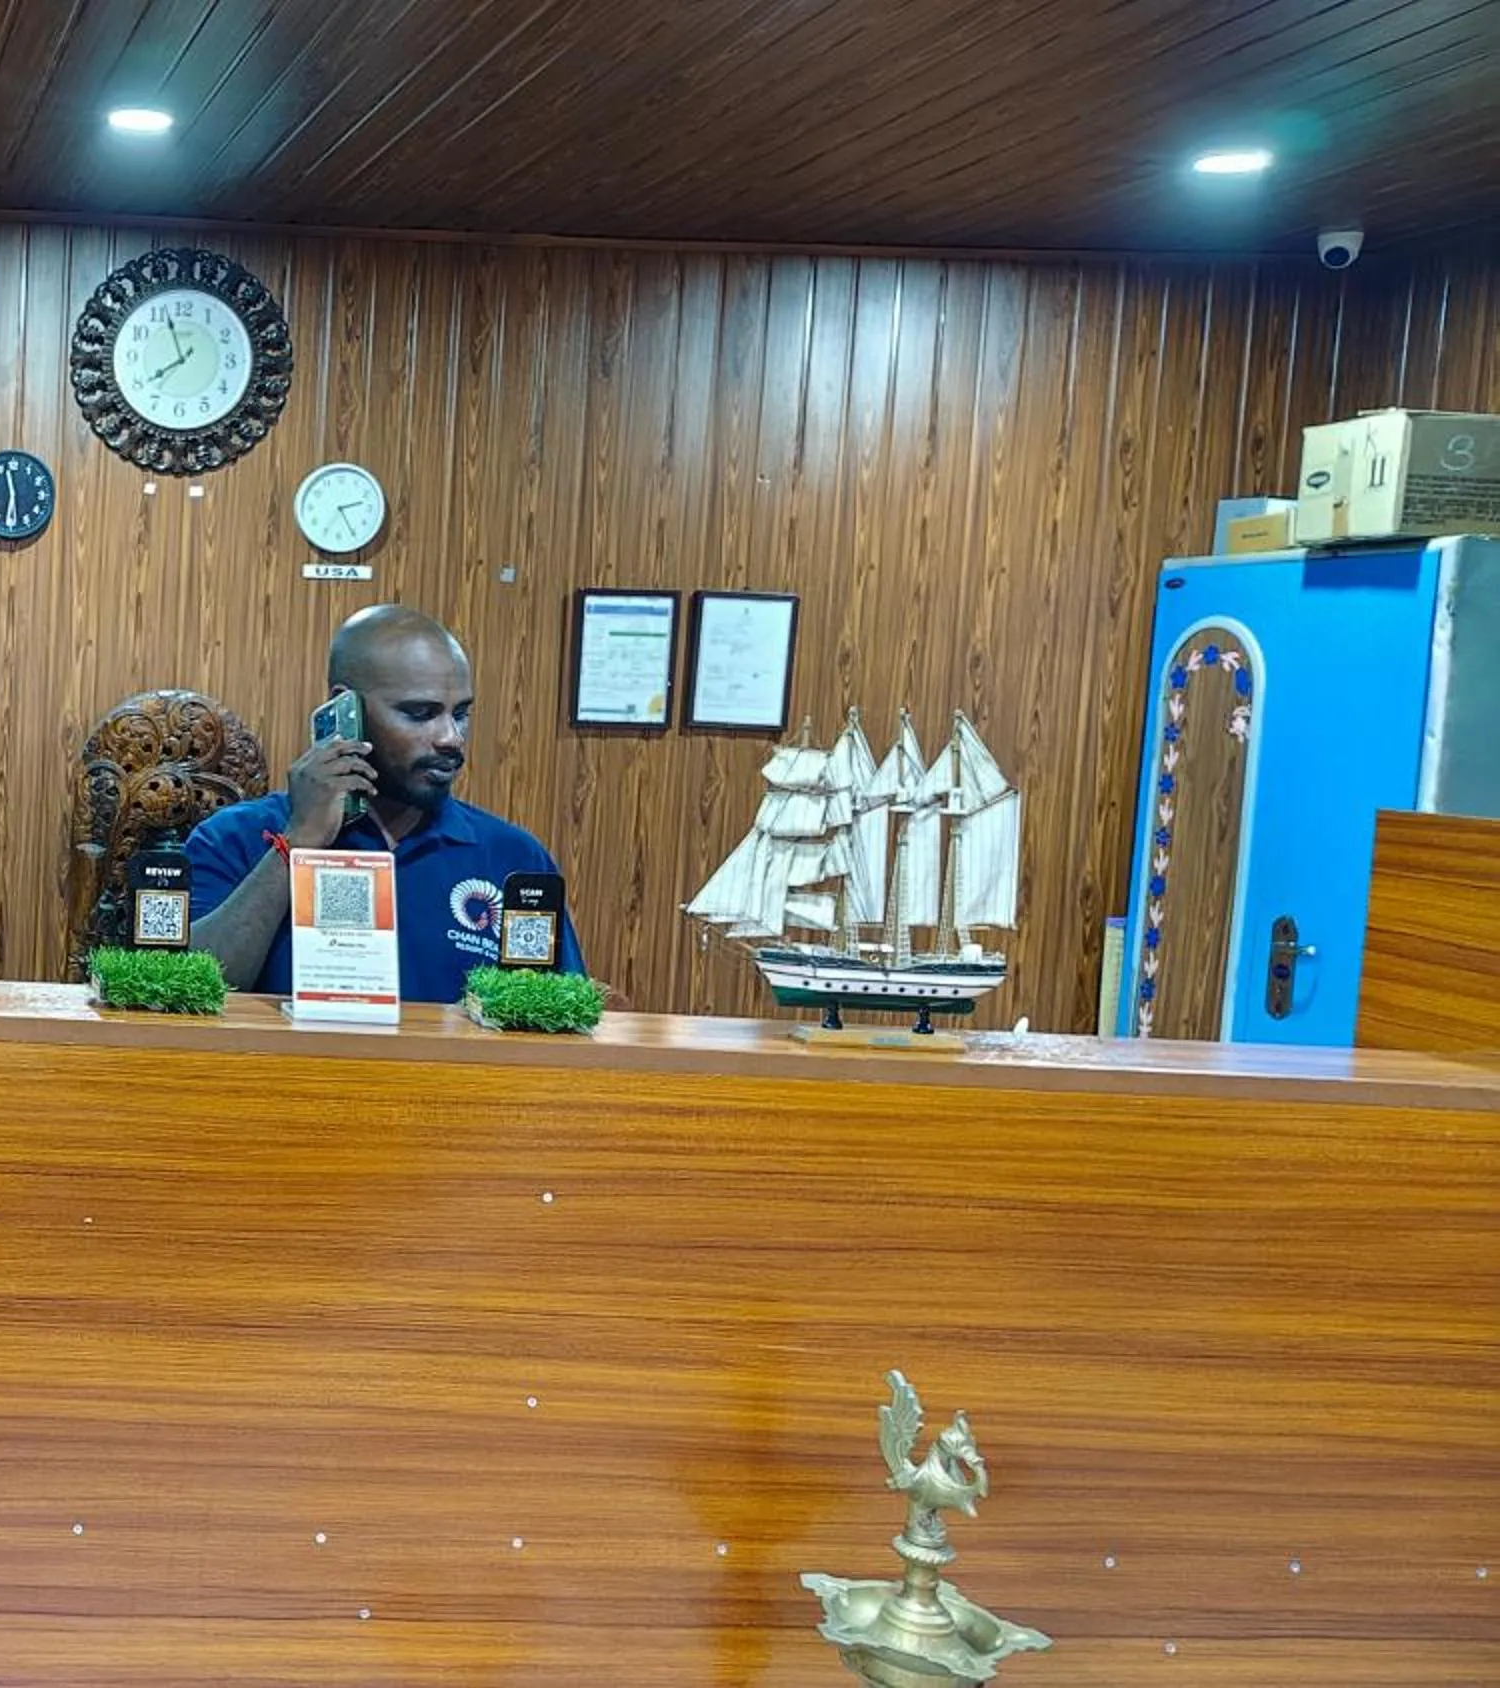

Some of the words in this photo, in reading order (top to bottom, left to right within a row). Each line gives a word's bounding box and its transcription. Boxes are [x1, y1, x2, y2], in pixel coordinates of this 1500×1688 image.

[151, 306, 165, 322] 11
[174, 301, 193, 317] 12
[132, 325, 149, 342] 10
[219, 327, 231, 345] 2
[126, 350, 138, 365] 9
[225, 352, 237, 369] 3
[218, 379, 228, 395] 4
[150, 395, 160, 411] 7
[173, 402, 185, 417] 6
[199, 396, 211, 413] 5
[1440, 434, 1476, 471] 3
[315, 567, 359, 577] USA
[145, 866, 183, 878] REVIEW
[519, 889, 544, 897] SCAN
[447, 929, 481, 945] CHAN
